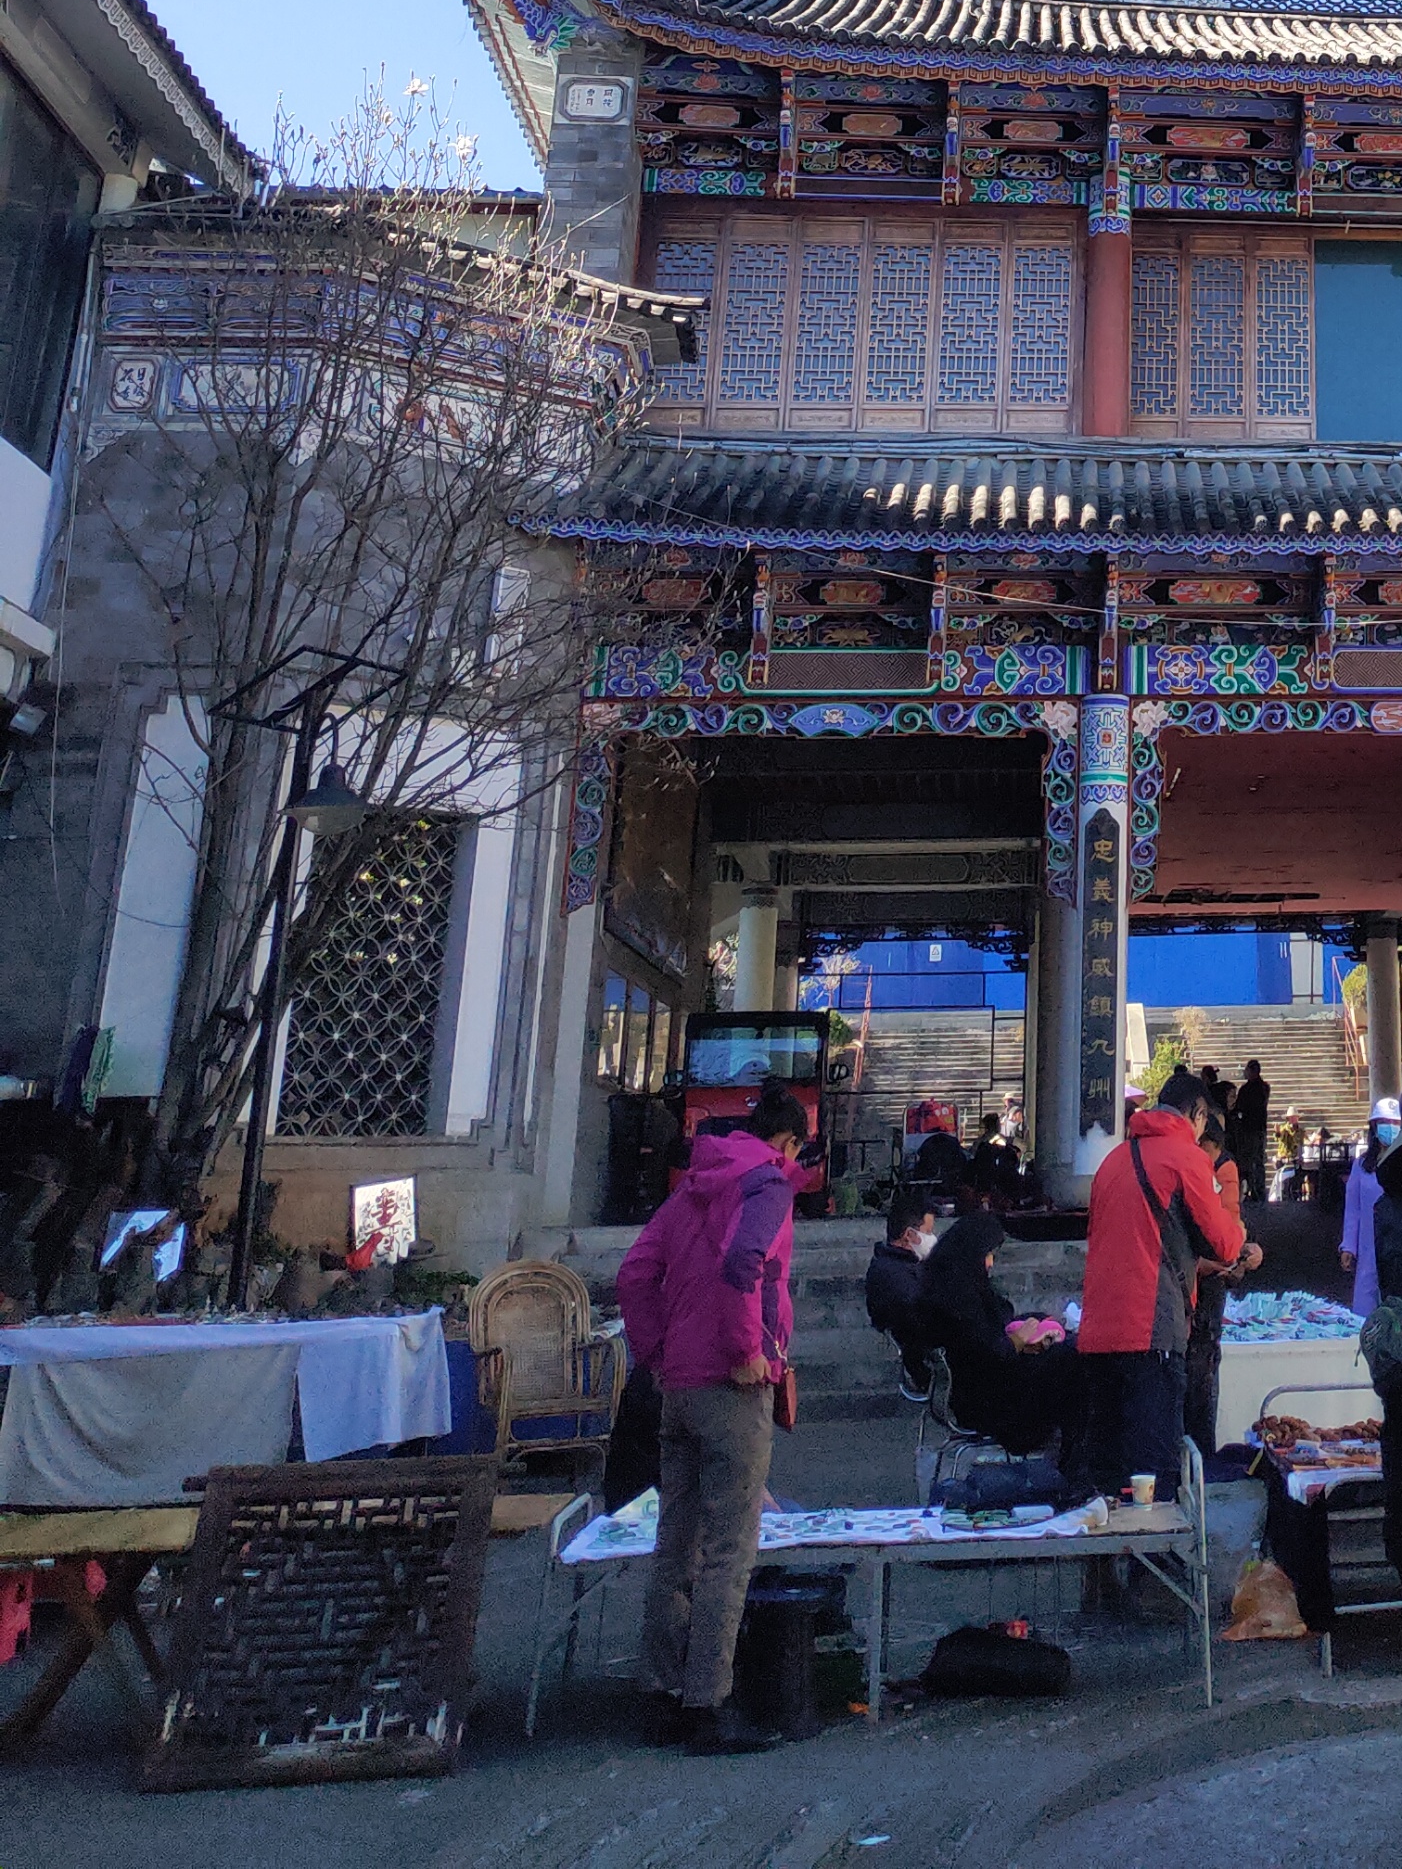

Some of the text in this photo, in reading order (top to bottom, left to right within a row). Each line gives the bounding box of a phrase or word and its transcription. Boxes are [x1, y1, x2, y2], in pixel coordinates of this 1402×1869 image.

[1086, 838, 1116, 1100] 忠義神威鎮九州
